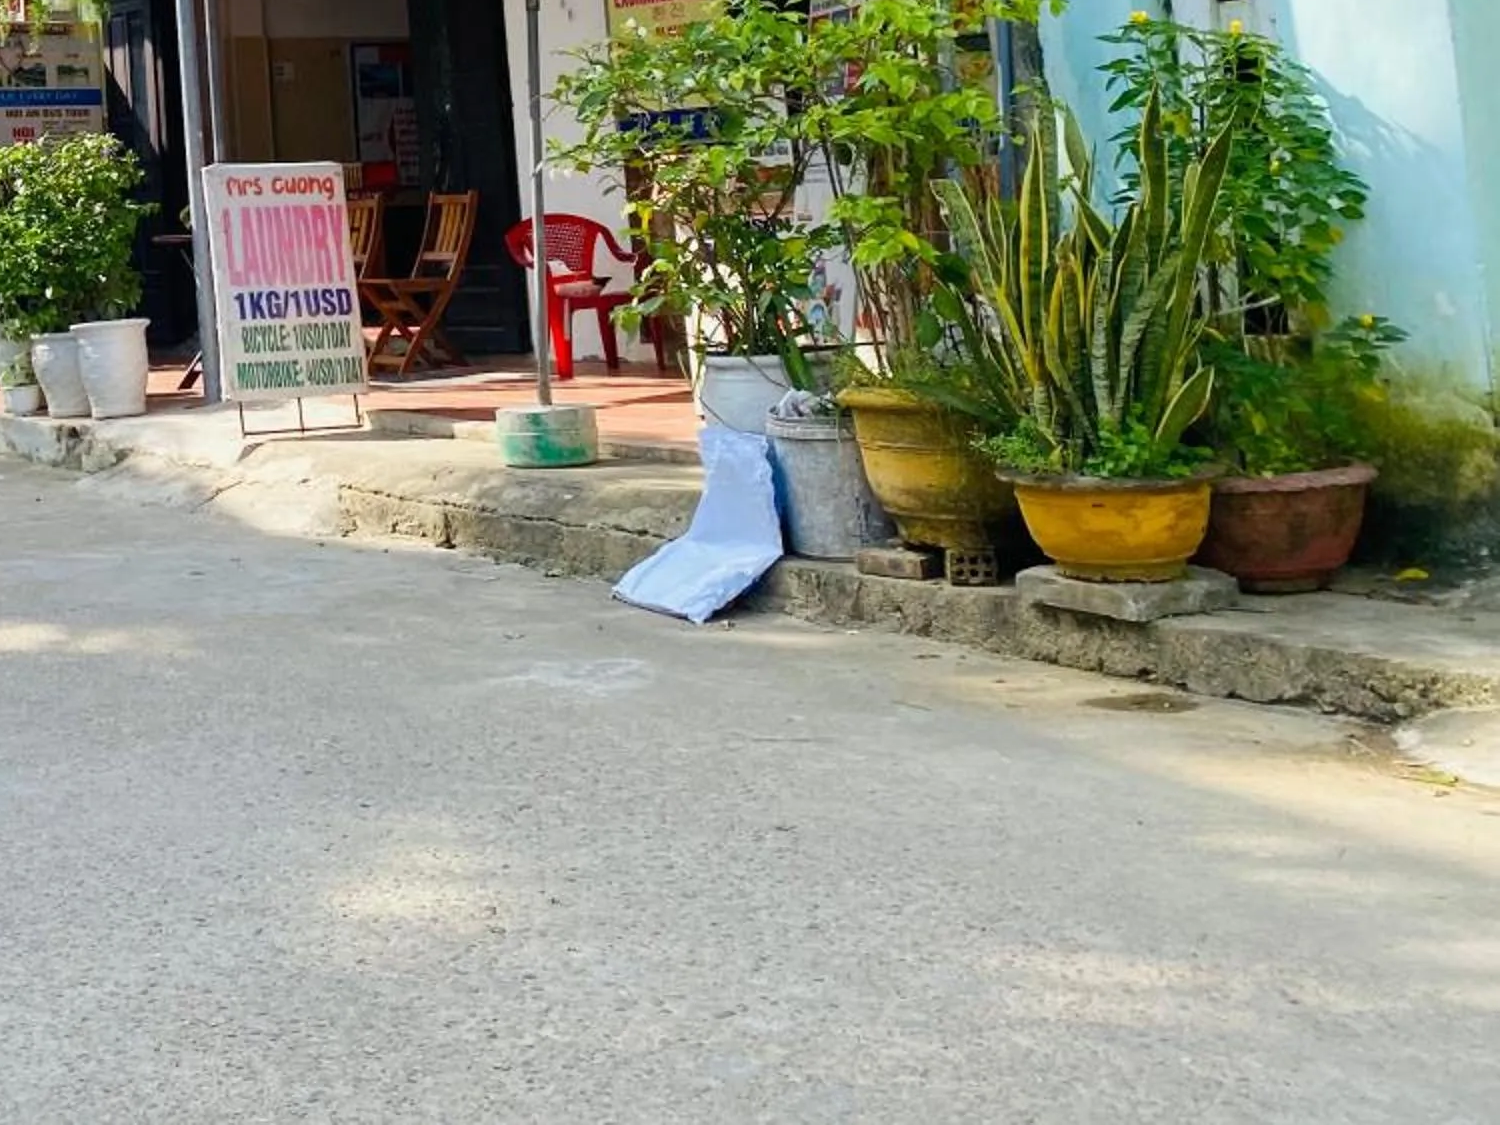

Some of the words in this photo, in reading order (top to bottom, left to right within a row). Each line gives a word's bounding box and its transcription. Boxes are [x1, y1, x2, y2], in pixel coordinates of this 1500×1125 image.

[227, 176, 263, 196] Mrs
[221, 204, 347, 286] LAUNDRY
[234, 288, 353, 320] 1KG/1USD
